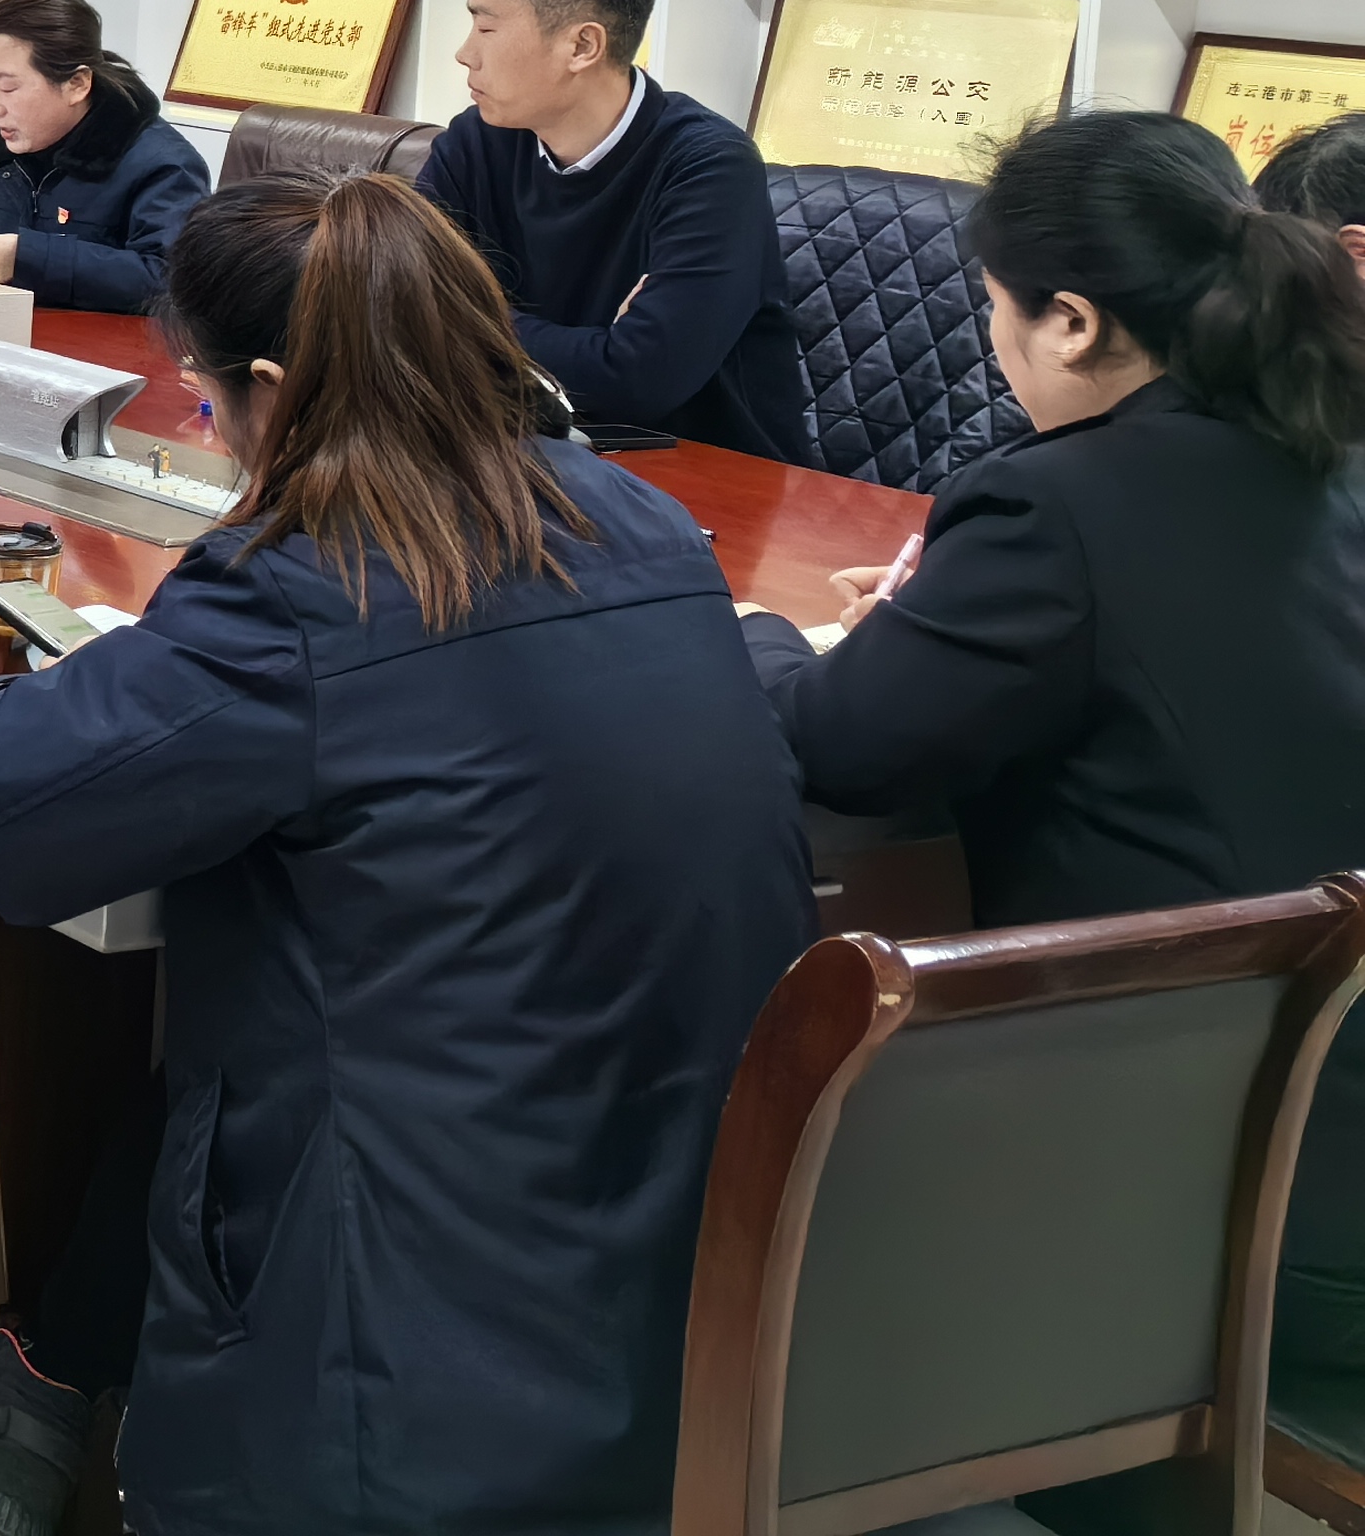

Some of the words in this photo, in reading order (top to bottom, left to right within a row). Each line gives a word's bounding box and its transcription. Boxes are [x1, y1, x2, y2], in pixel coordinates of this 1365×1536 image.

[827, 66, 992, 102] 新能源公交
[1226, 82, 1349, 108] 连云港市第三批
